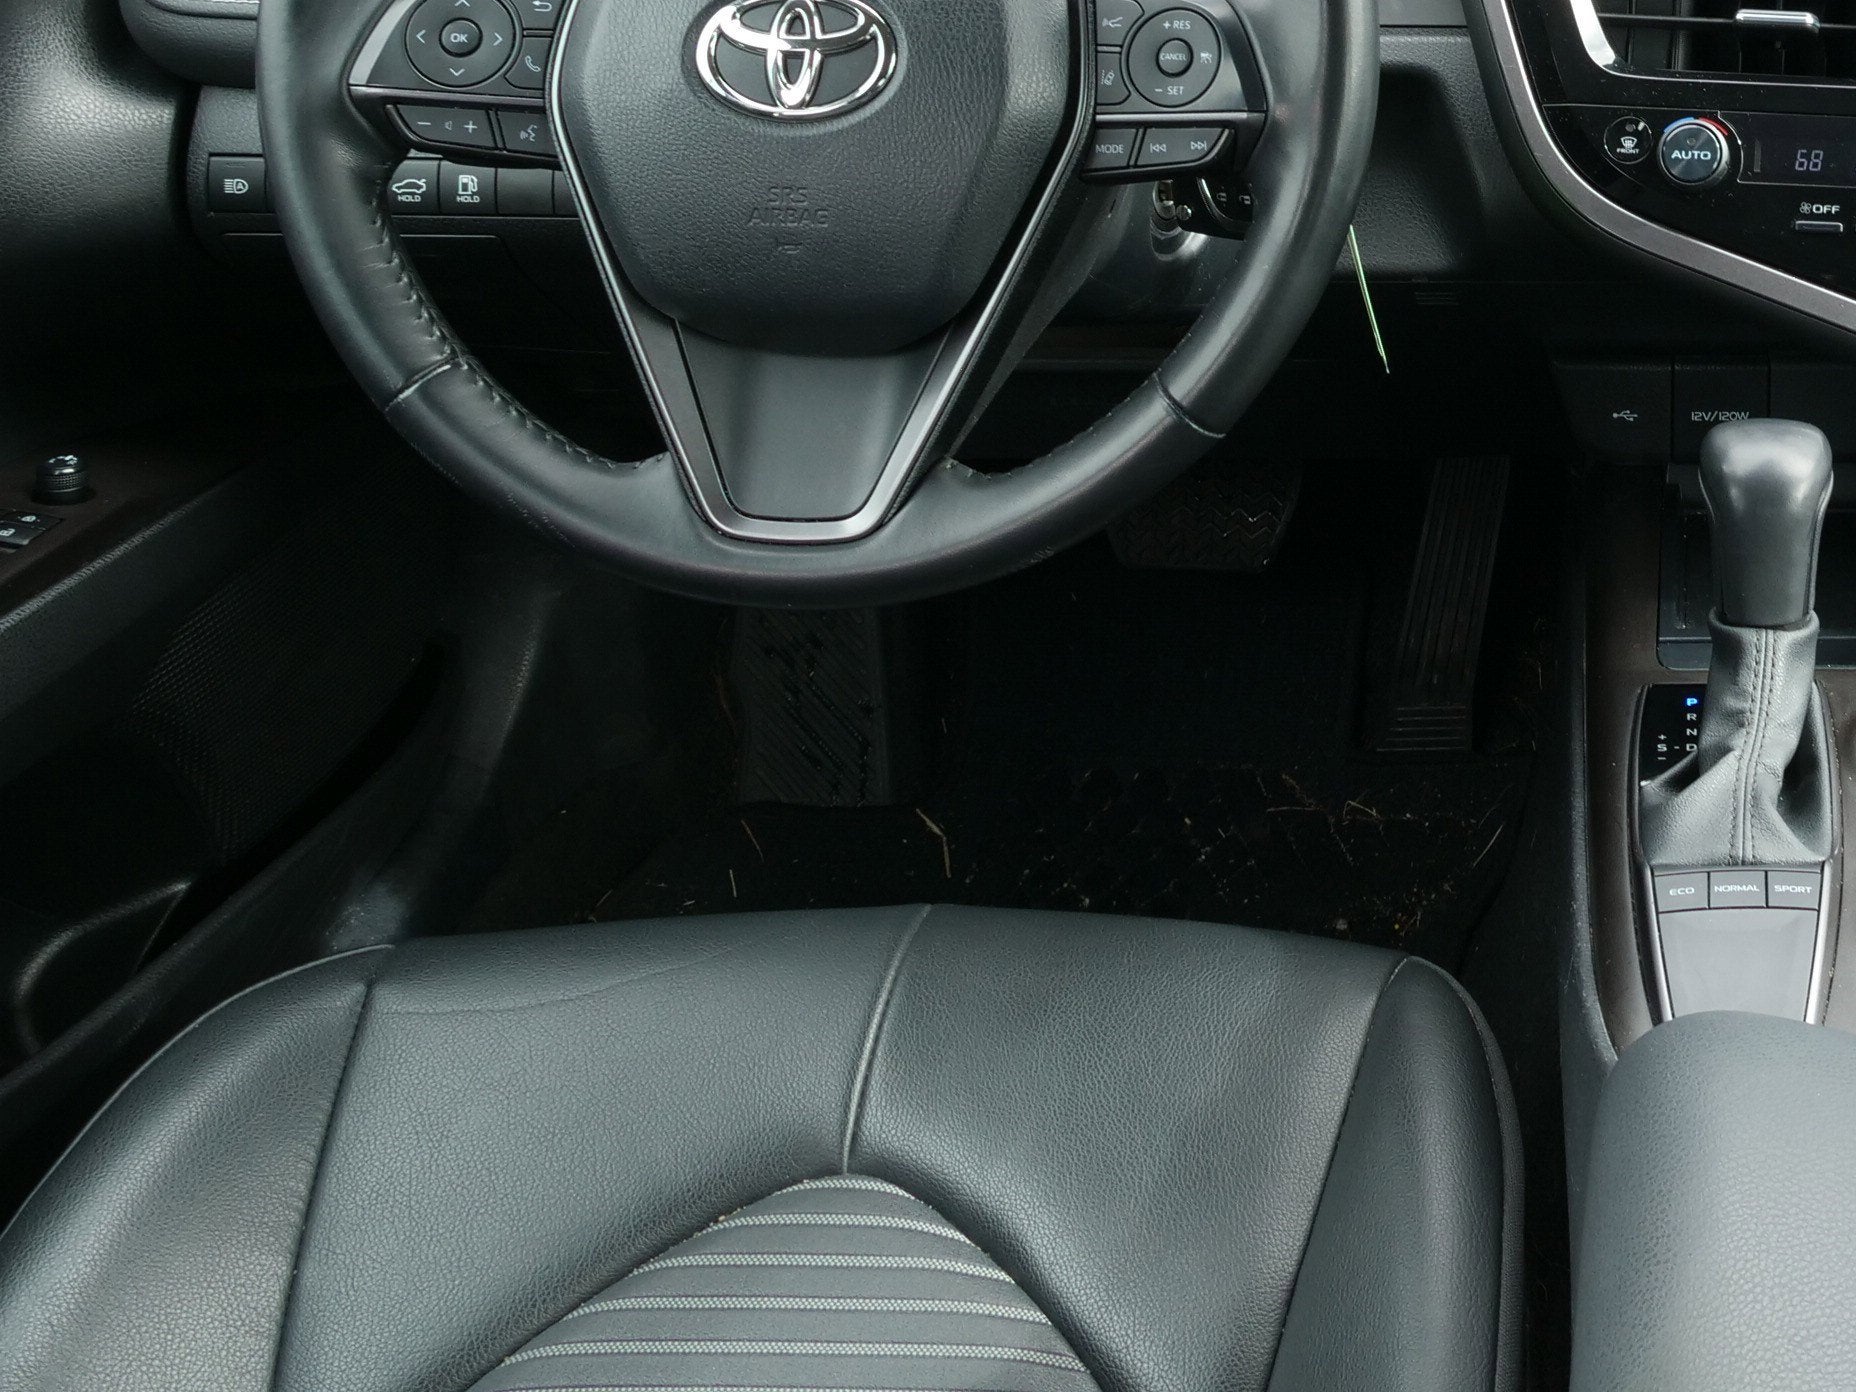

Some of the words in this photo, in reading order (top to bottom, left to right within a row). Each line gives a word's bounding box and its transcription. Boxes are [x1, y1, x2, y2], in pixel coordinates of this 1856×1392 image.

[1173, 20, 1191, 29] RES
[450, 32, 469, 43] OK
[1160, 52, 1187, 61] CANCEL
[1167, 86, 1184, 95] SET
[1095, 144, 1124, 154] MODE
[1671, 150, 1712, 160] AUTO
[1795, 149, 1824, 172] 68
[457, 195, 480, 203] HOLD
[766, 186, 808, 205] SRS
[1812, 204, 1841, 214] OFF
[746, 208, 829, 227] AIRBAG
[1691, 411, 1750, 422] 12V/120W
[1686, 697, 1698, 707] P
[1686, 712, 1697, 721] R
[1686, 727, 1697, 737] N
[1657, 743, 1667, 752] S
[1686, 743, 1697, 752] D
[1669, 886, 1695, 896] ECO
[1713, 883, 1760, 893] NORMAL
[1774, 884, 1812, 894] SPORT
